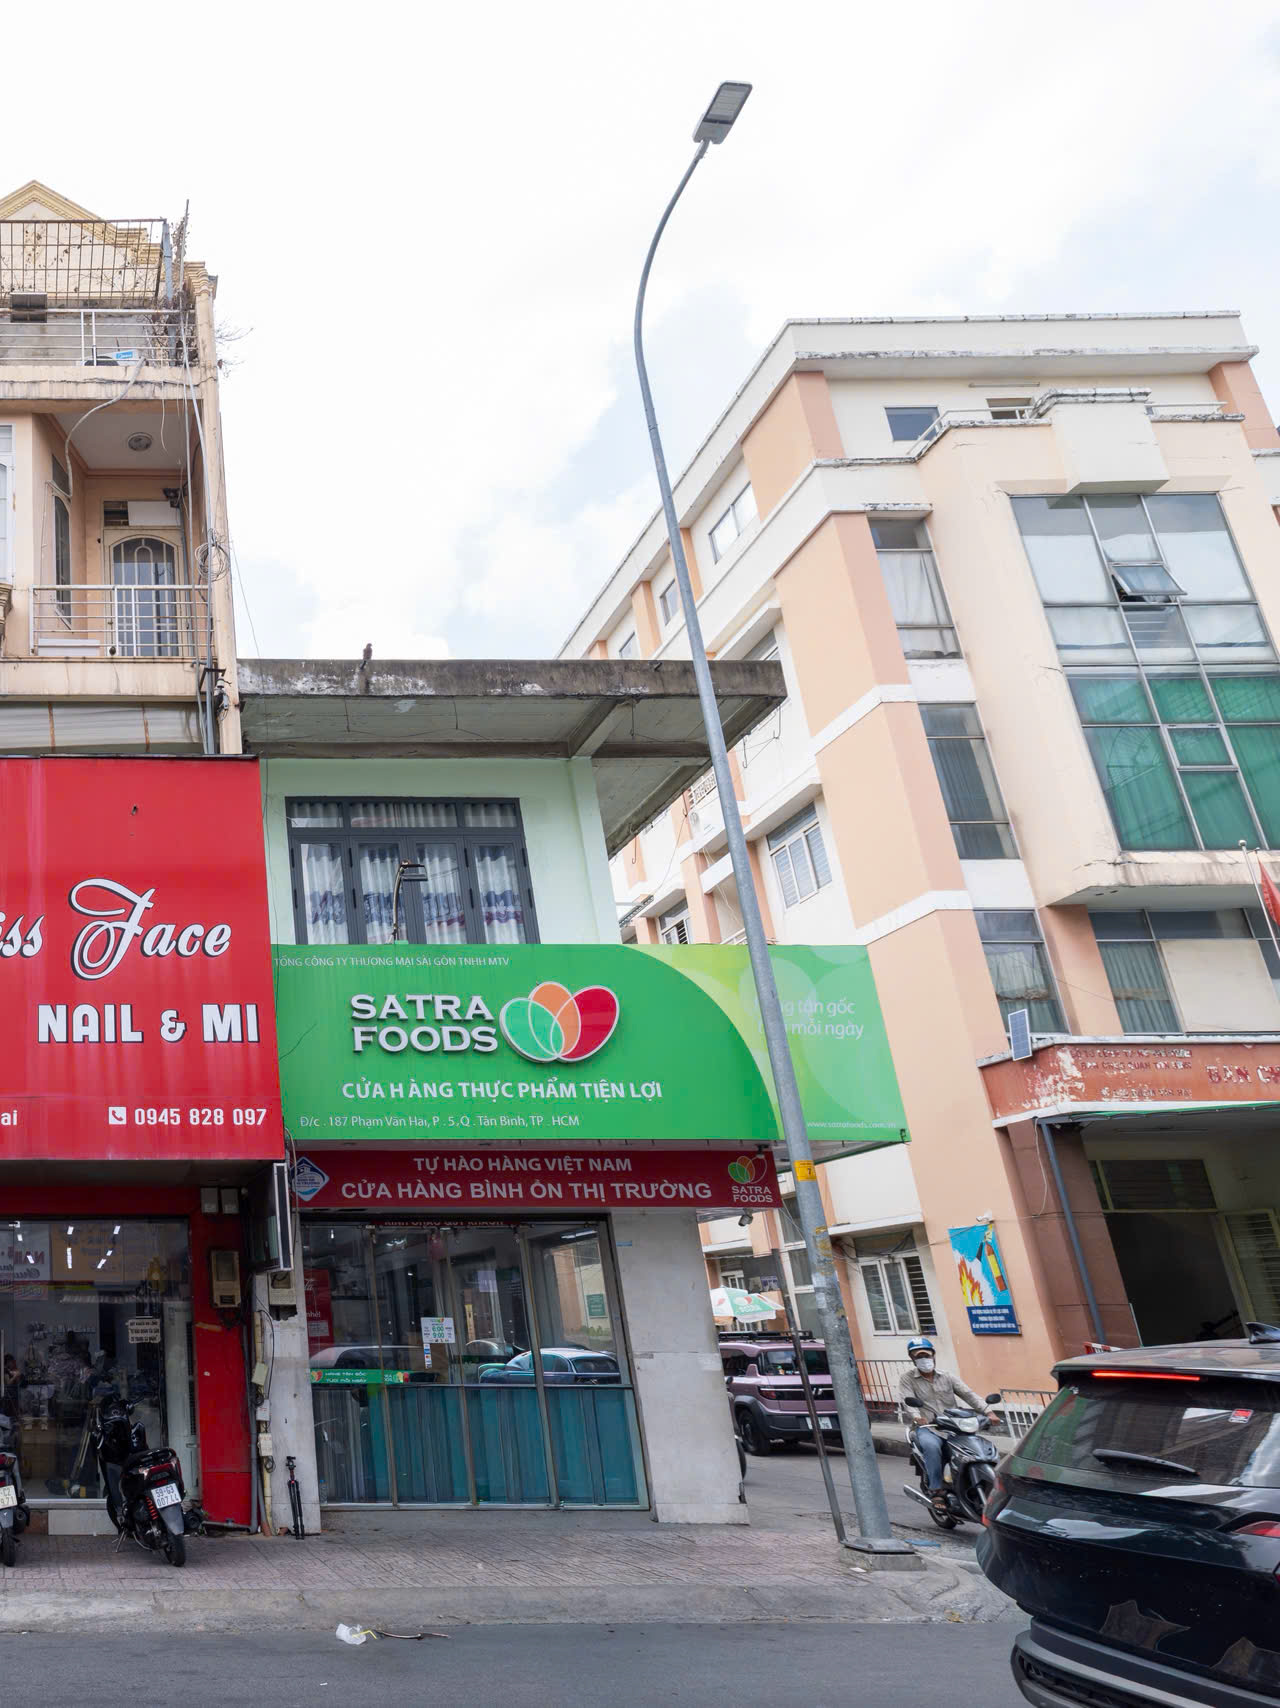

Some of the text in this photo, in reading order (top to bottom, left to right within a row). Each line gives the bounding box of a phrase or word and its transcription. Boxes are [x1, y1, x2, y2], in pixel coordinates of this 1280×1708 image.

[68, 877, 233, 981] Face
[304, 954, 334, 967] CÔNG
[335, 956, 348, 966] TY
[349, 955, 393, 967] THƯƠNG
[395, 956, 415, 968] MẠI
[433, 954, 457, 967] GÒN
[458, 956, 487, 967] TNHH
[488, 956, 509, 966] MTV
[350, 993, 495, 1021] SATRA
[36, 1003, 261, 1045] NAIL & MI
[825, 1019, 864, 1041] ngày
[352, 1025, 499, 1053] FOODS
[342, 1076, 386, 1099] CỬA
[457, 1079, 514, 1103] THỰC
[518, 1076, 577, 1099] PHẨM
[580, 1079, 625, 1103] TIỆN
[629, 1080, 663, 1102] LỢI
[133, 1107, 268, 1127] 0945 828 097
[329, 1116, 348, 1127] 187
[351, 1115, 384, 1129] Phạm
[413, 1155, 633, 1175] TỰ HÀO HÀNG VIỆT NAM
[341, 1179, 393, 1199] CỬA
[397, 1179, 462, 1199] HÀNG
[470, 1179, 524, 1199] BÌNH
[568, 1182, 606, 1202] THỊ
[610, 1179, 713, 1200] TRƯỜNG
[731, 1185, 772, 1195] SATRA
[732, 1194, 774, 1203] FOODS
